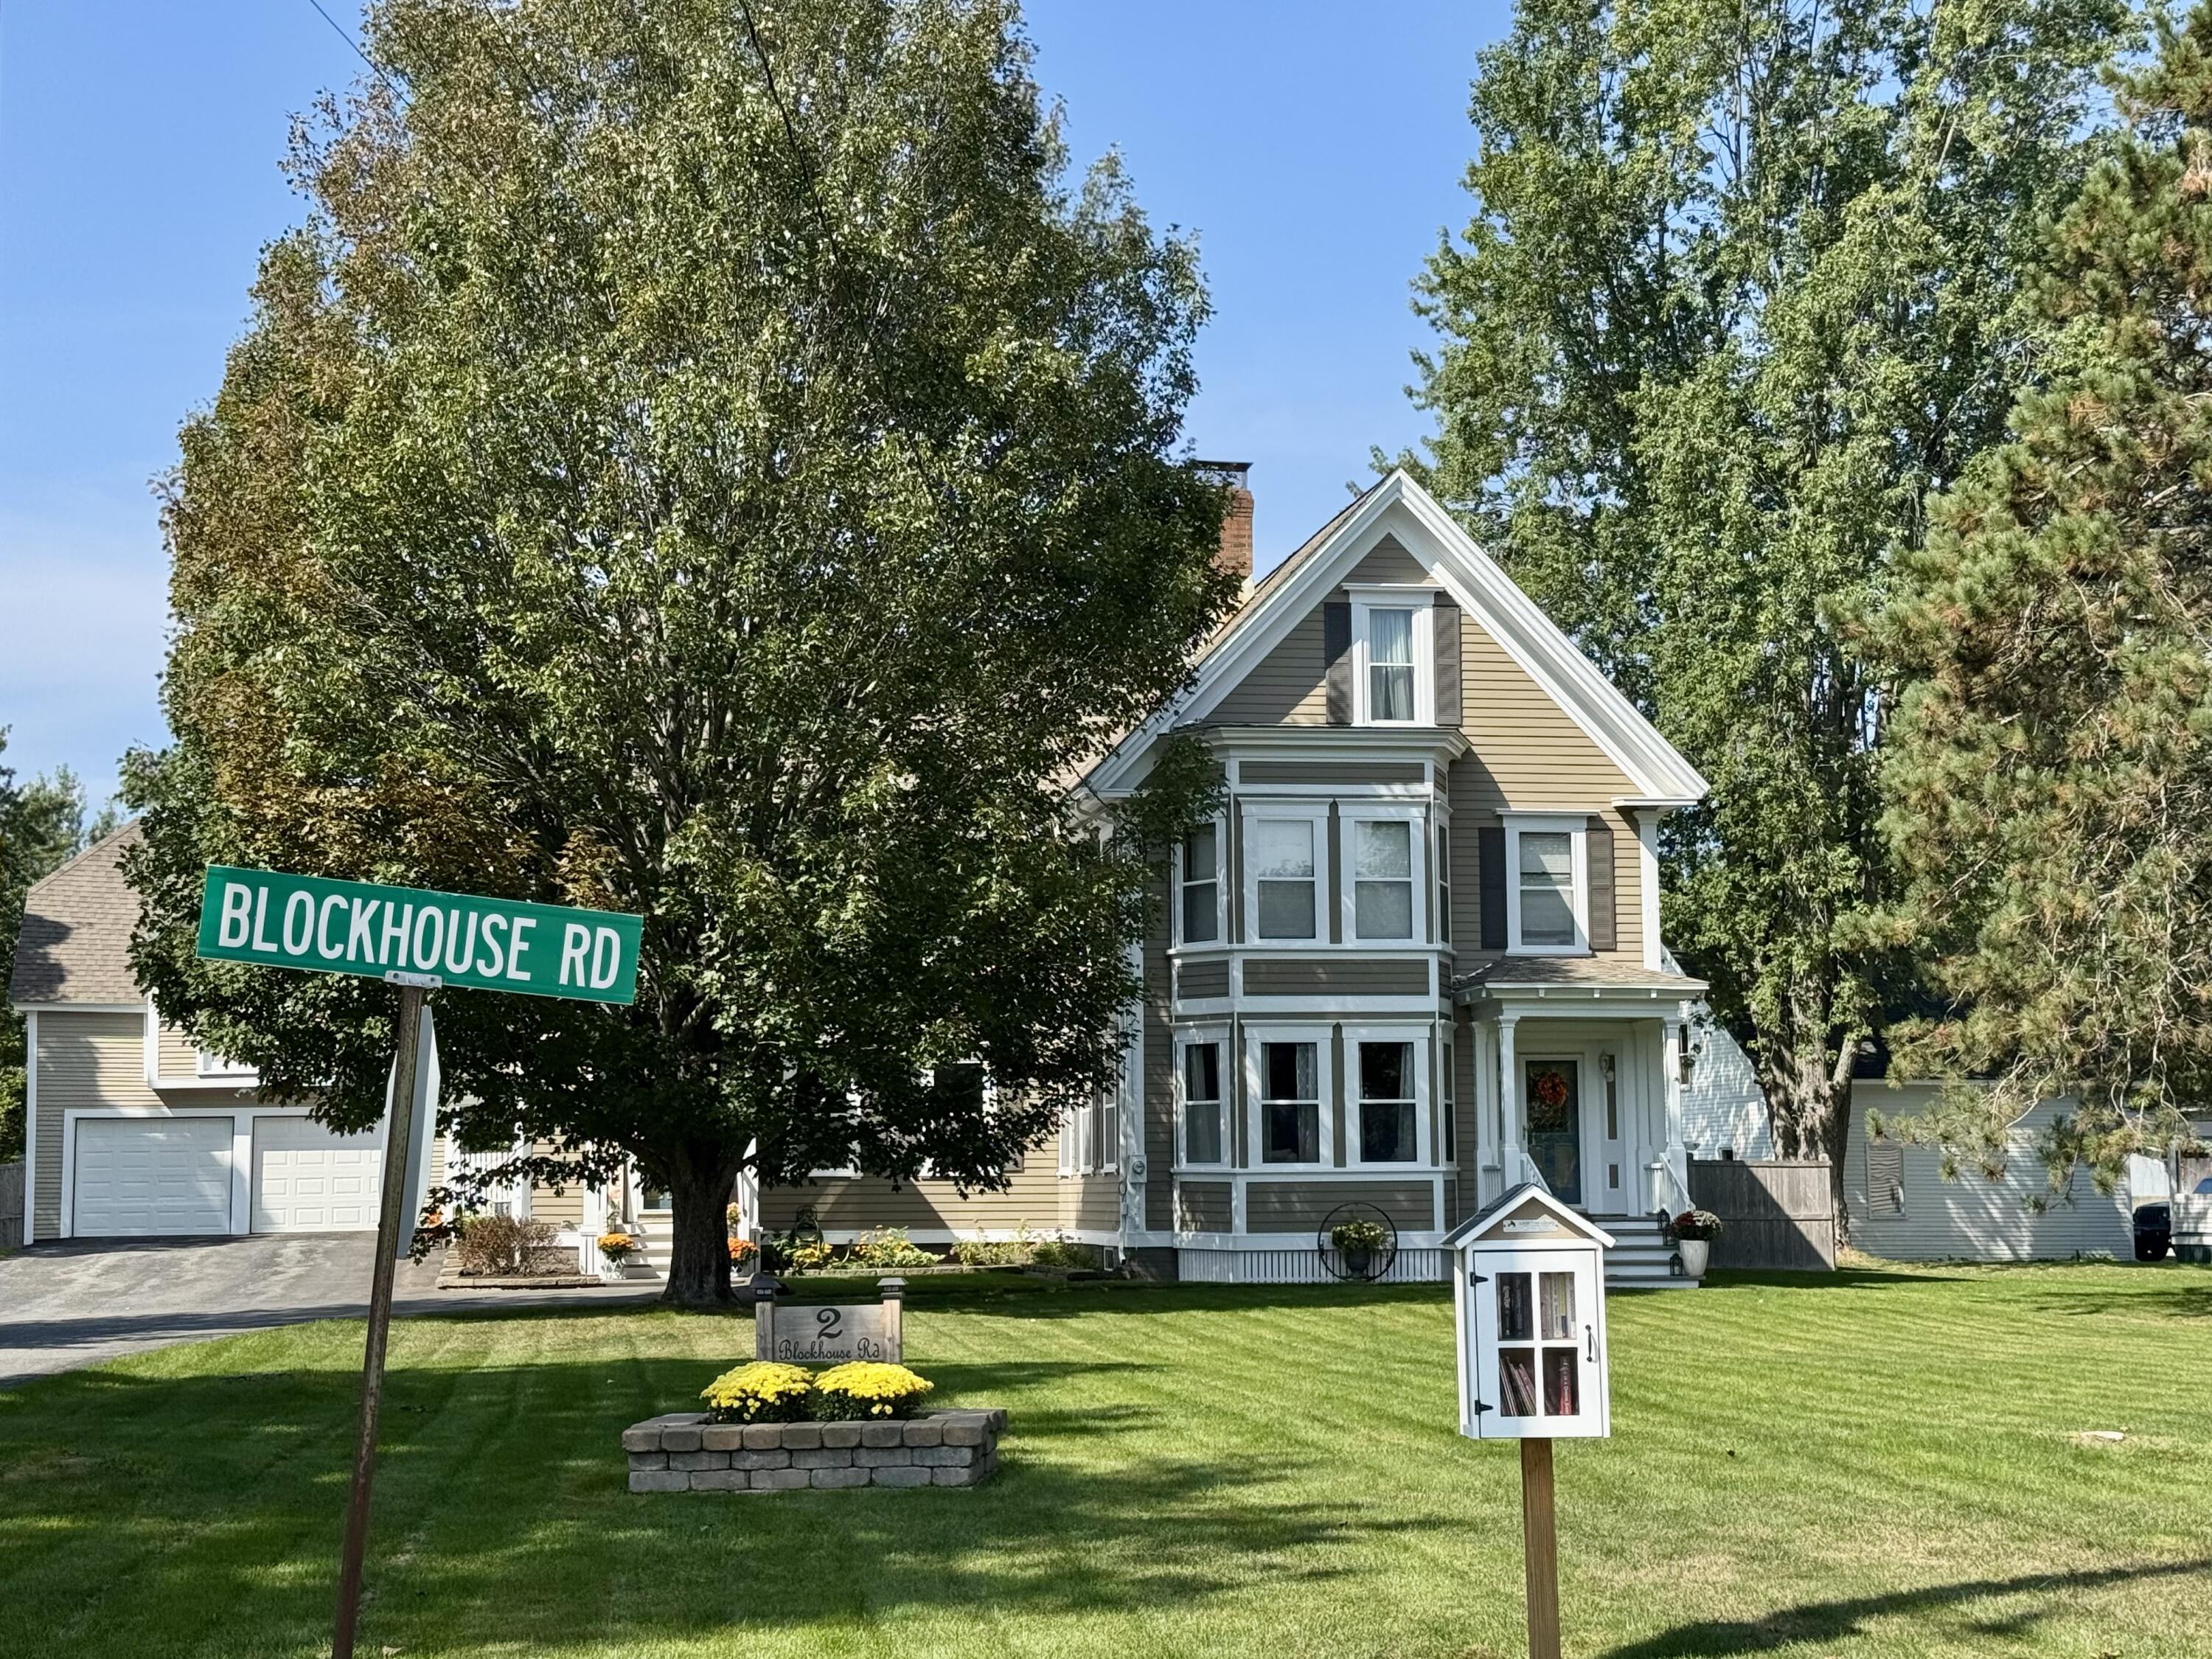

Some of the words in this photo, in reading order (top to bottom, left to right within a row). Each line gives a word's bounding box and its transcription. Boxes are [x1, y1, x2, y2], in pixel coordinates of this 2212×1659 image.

[218, 883, 537, 982] BLOCKHOUSE
[559, 922, 621, 990] RD
[816, 1307, 843, 1339] 2
[779, 1339, 852, 1360] Blockhouse
[858, 1337, 880, 1358] Rd
